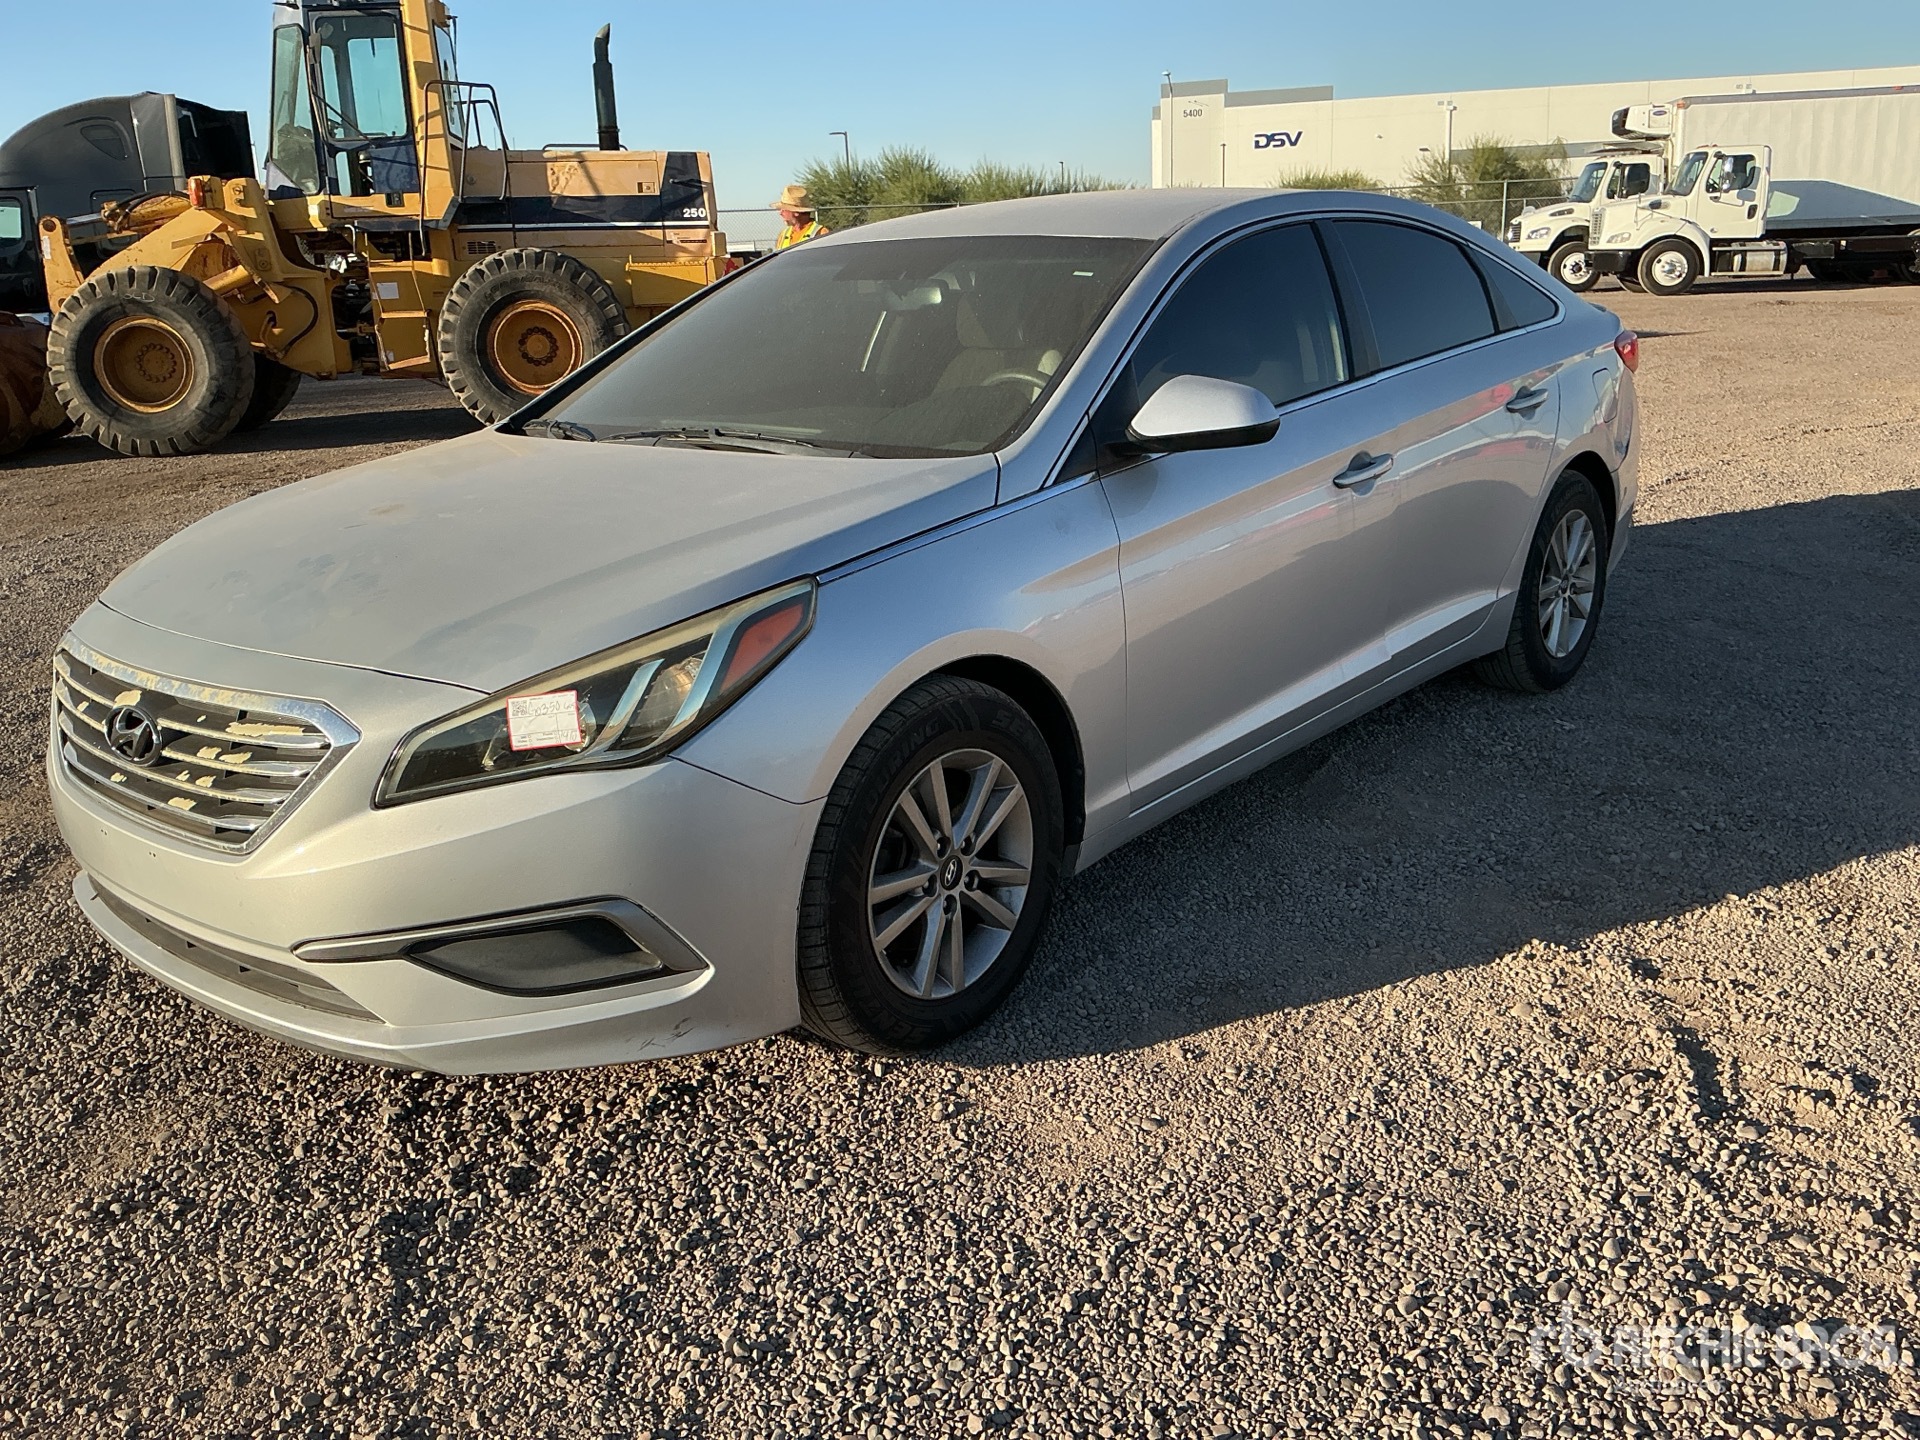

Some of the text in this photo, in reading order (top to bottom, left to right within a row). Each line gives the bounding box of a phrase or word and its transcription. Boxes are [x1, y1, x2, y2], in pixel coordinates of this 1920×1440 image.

[1183, 109, 1203, 118] 5400
[1254, 131, 1303, 149] DSV
[682, 207, 707, 218] 250
